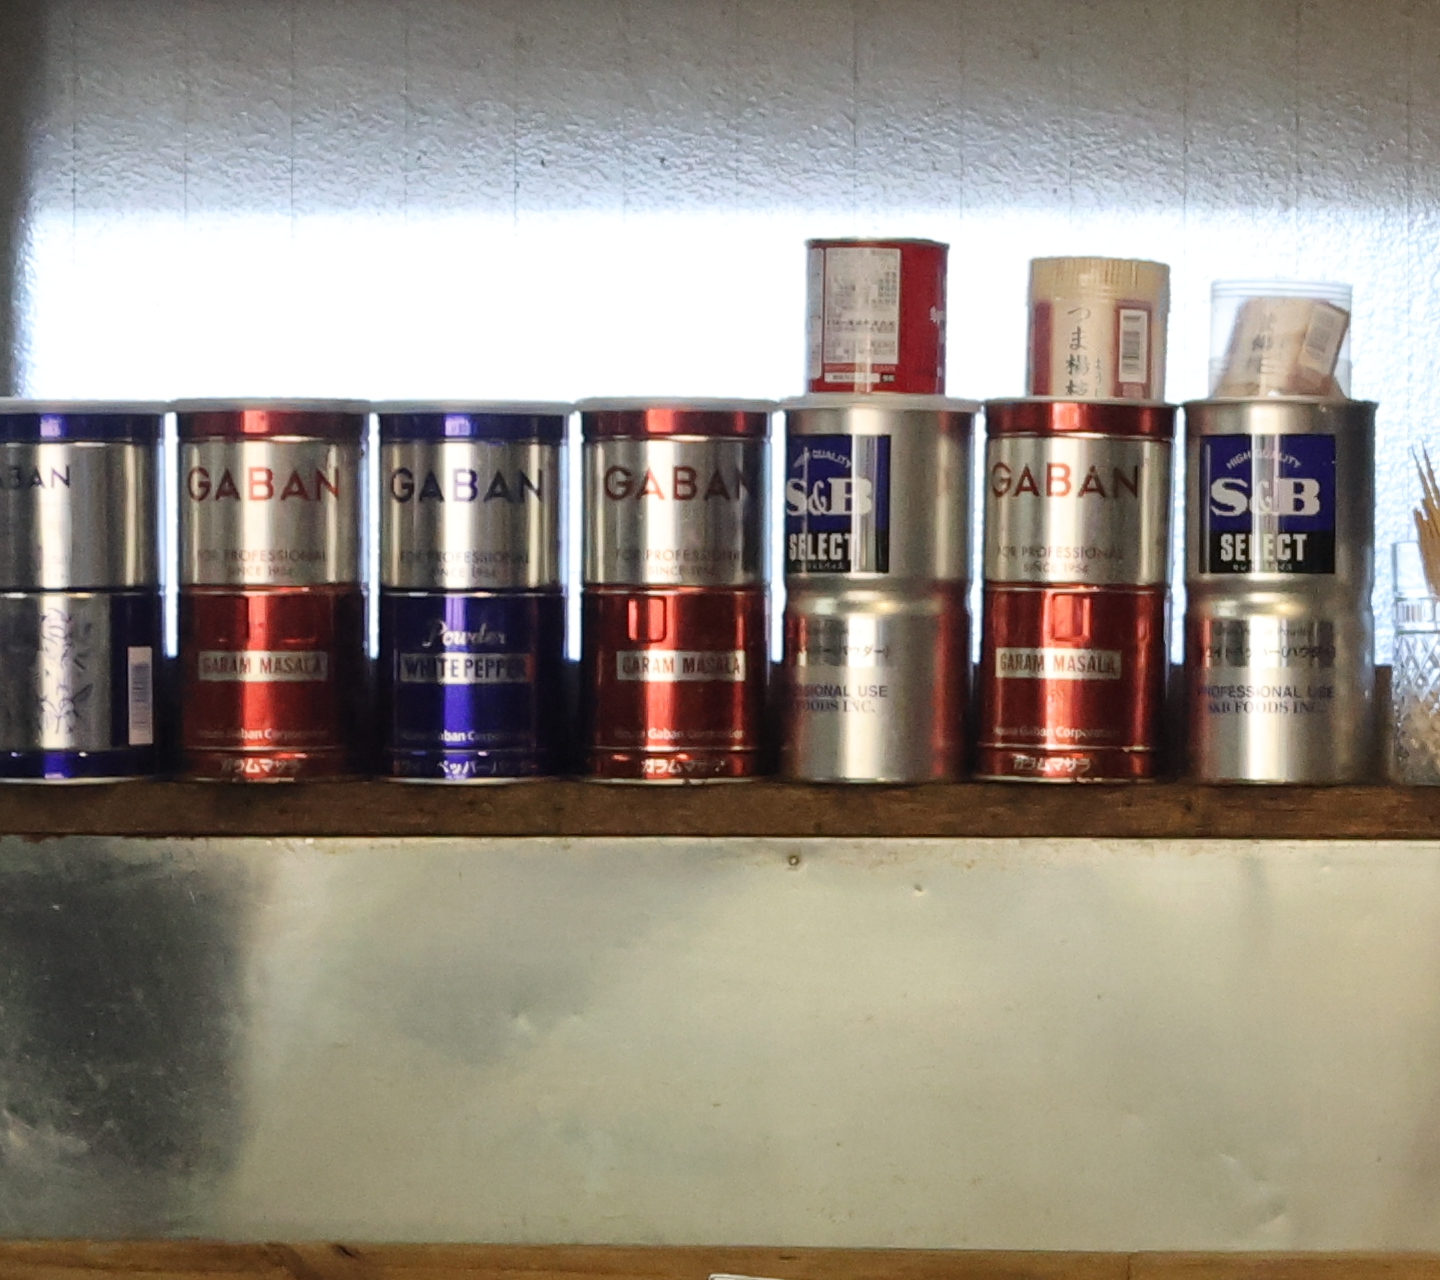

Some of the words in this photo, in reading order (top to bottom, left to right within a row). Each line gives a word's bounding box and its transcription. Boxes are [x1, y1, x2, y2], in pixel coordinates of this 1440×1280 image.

[1225, 451, 1252, 470] HIGH
[186, 465, 340, 502] GABAN
[389, 466, 543, 503] GABAN
[603, 465, 755, 502] GABAN
[991, 461, 1140, 499] GABAN
[786, 477, 872, 516] S&B
[1210, 477, 1321, 517] S&B
[1220, 532, 1308, 562] SELECT
[421, 619, 506, 648] Powder
[202, 654, 252, 675] GARAM
[259, 654, 324, 675] MASALA
[402, 656, 459, 678] WHITE
[621, 653, 675, 675] GARAM
[682, 653, 742, 674] MASALA
[1000, 653, 1045, 673] GARAM
[1052, 653, 1117, 674] MASALA
[858, 684, 888, 698] USE
[1233, 700, 1289, 714] FOODS
